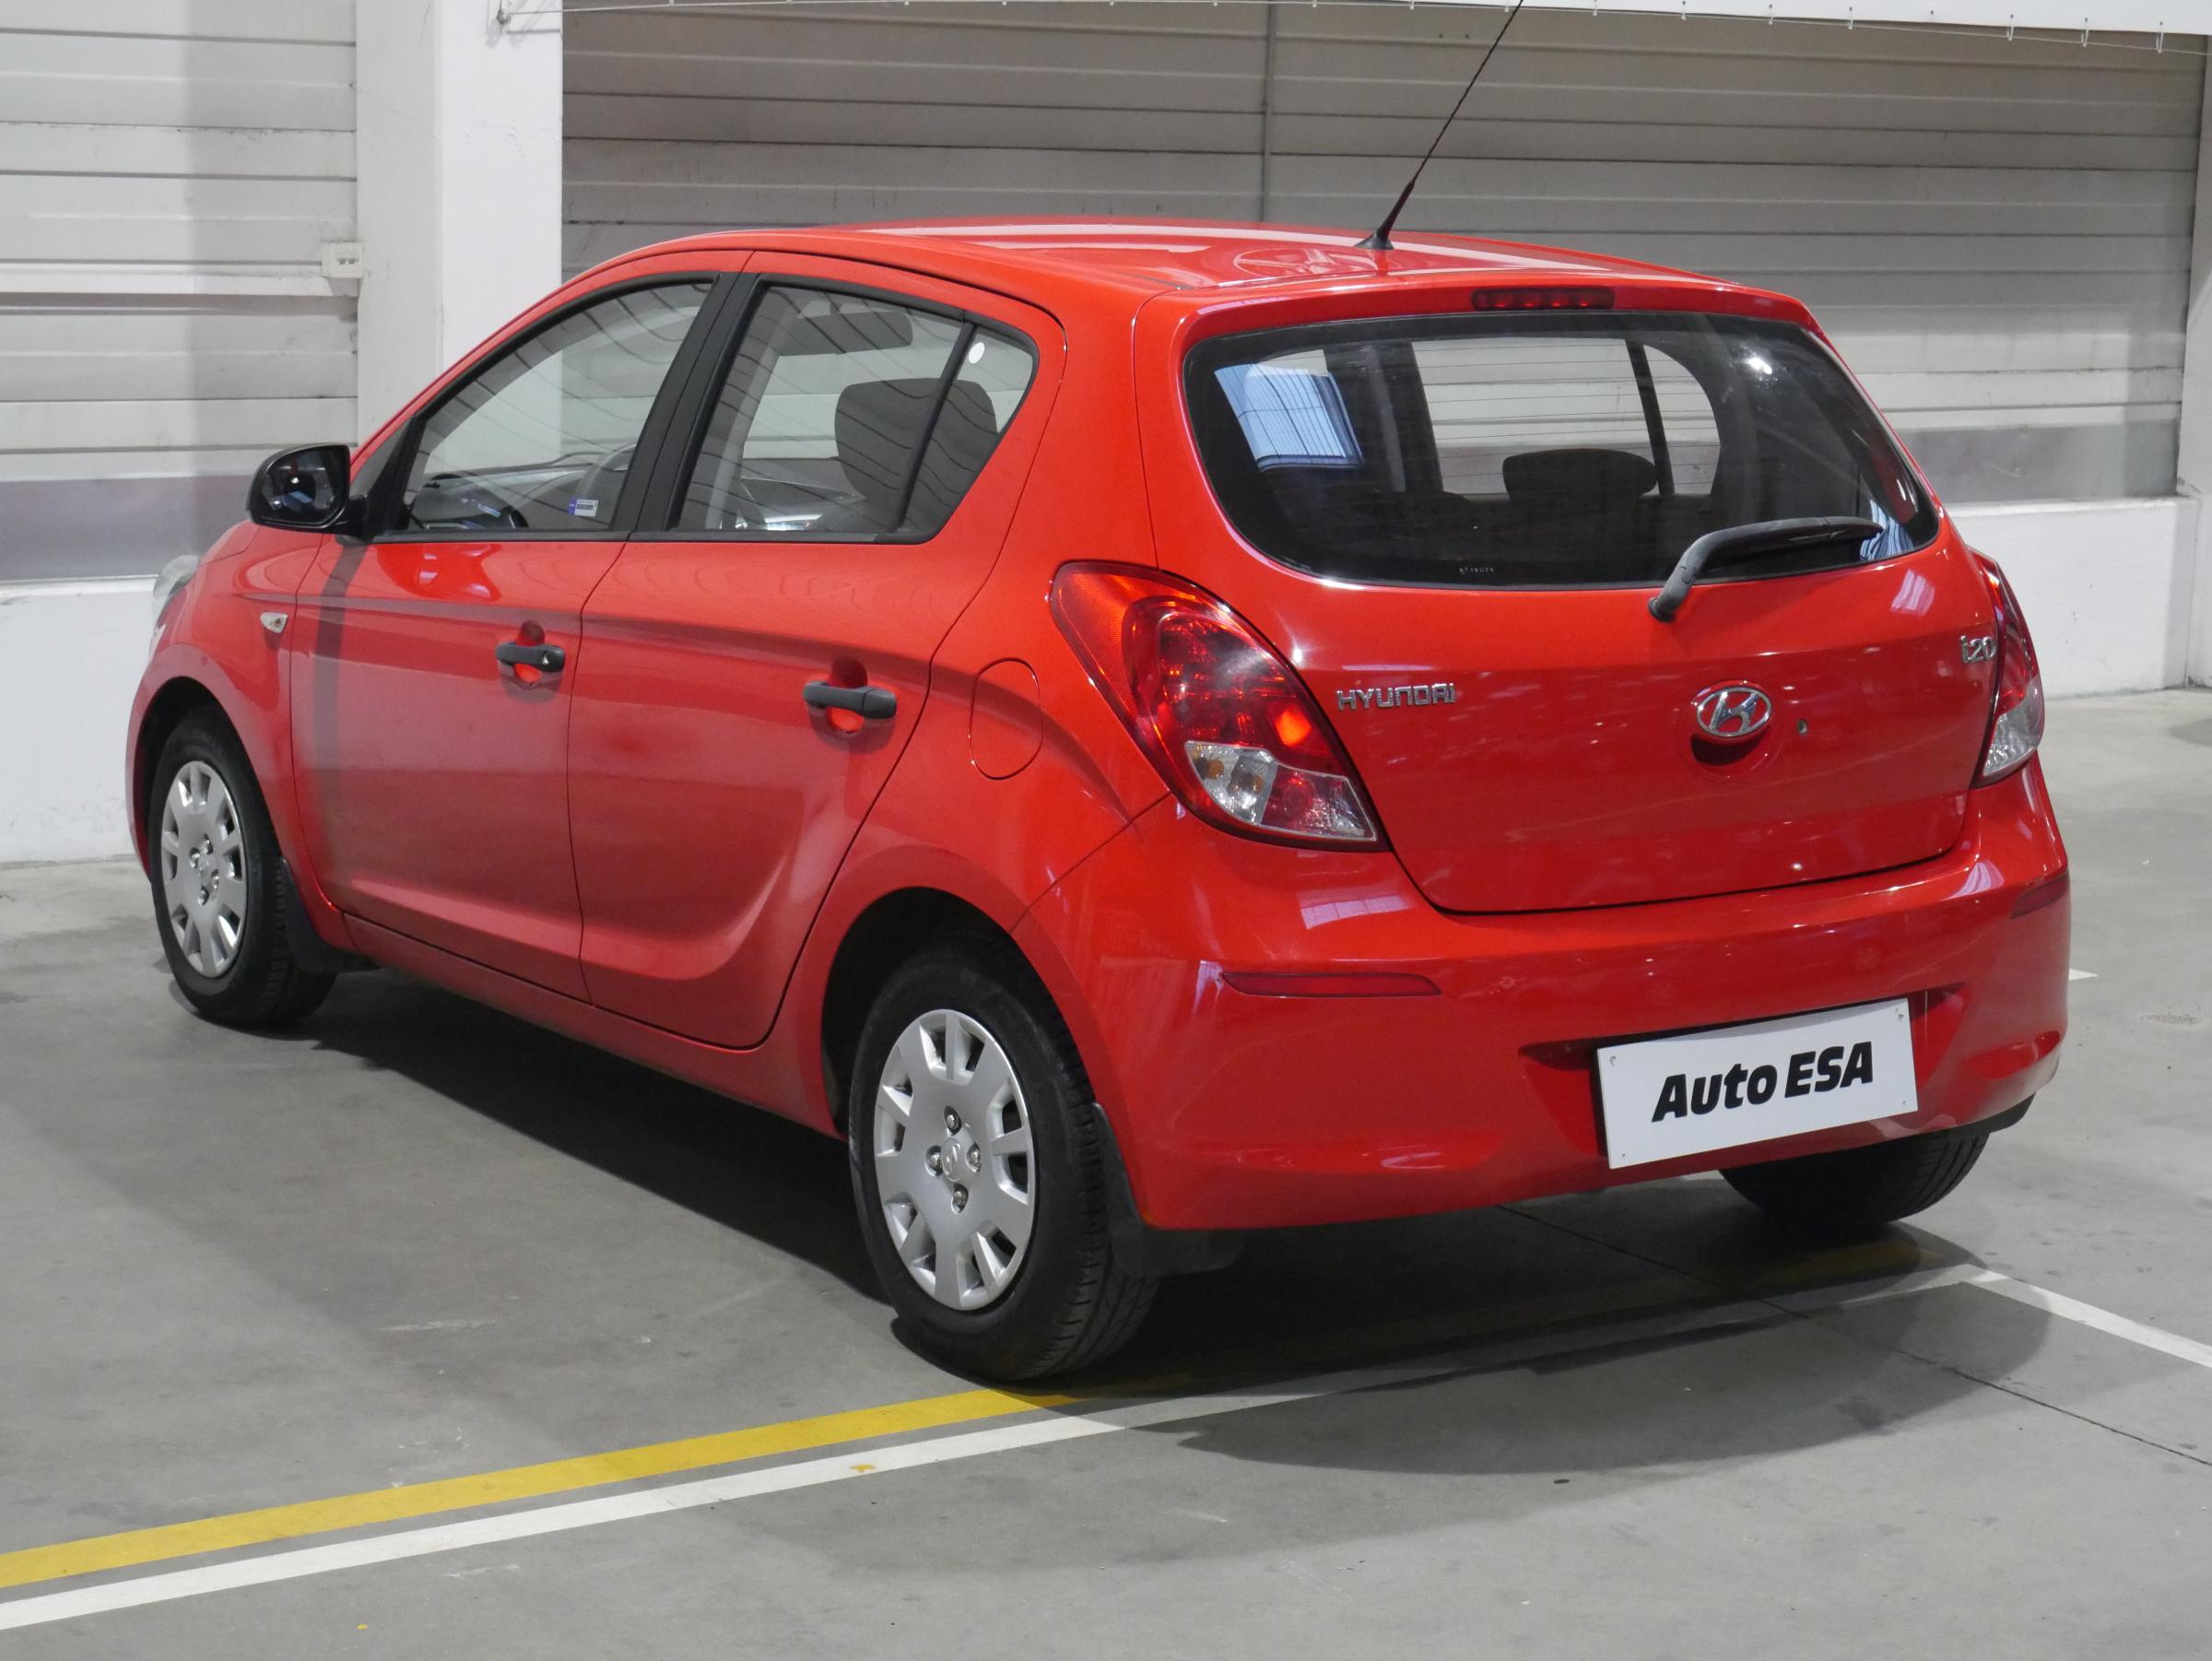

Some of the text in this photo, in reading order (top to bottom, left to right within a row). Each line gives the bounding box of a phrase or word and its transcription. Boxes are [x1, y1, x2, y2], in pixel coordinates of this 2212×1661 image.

[1960, 635, 1995, 664] i20
[1336, 682, 1456, 711] HYUNDAI
[1651, 1041, 1874, 1123] Auto ESA
